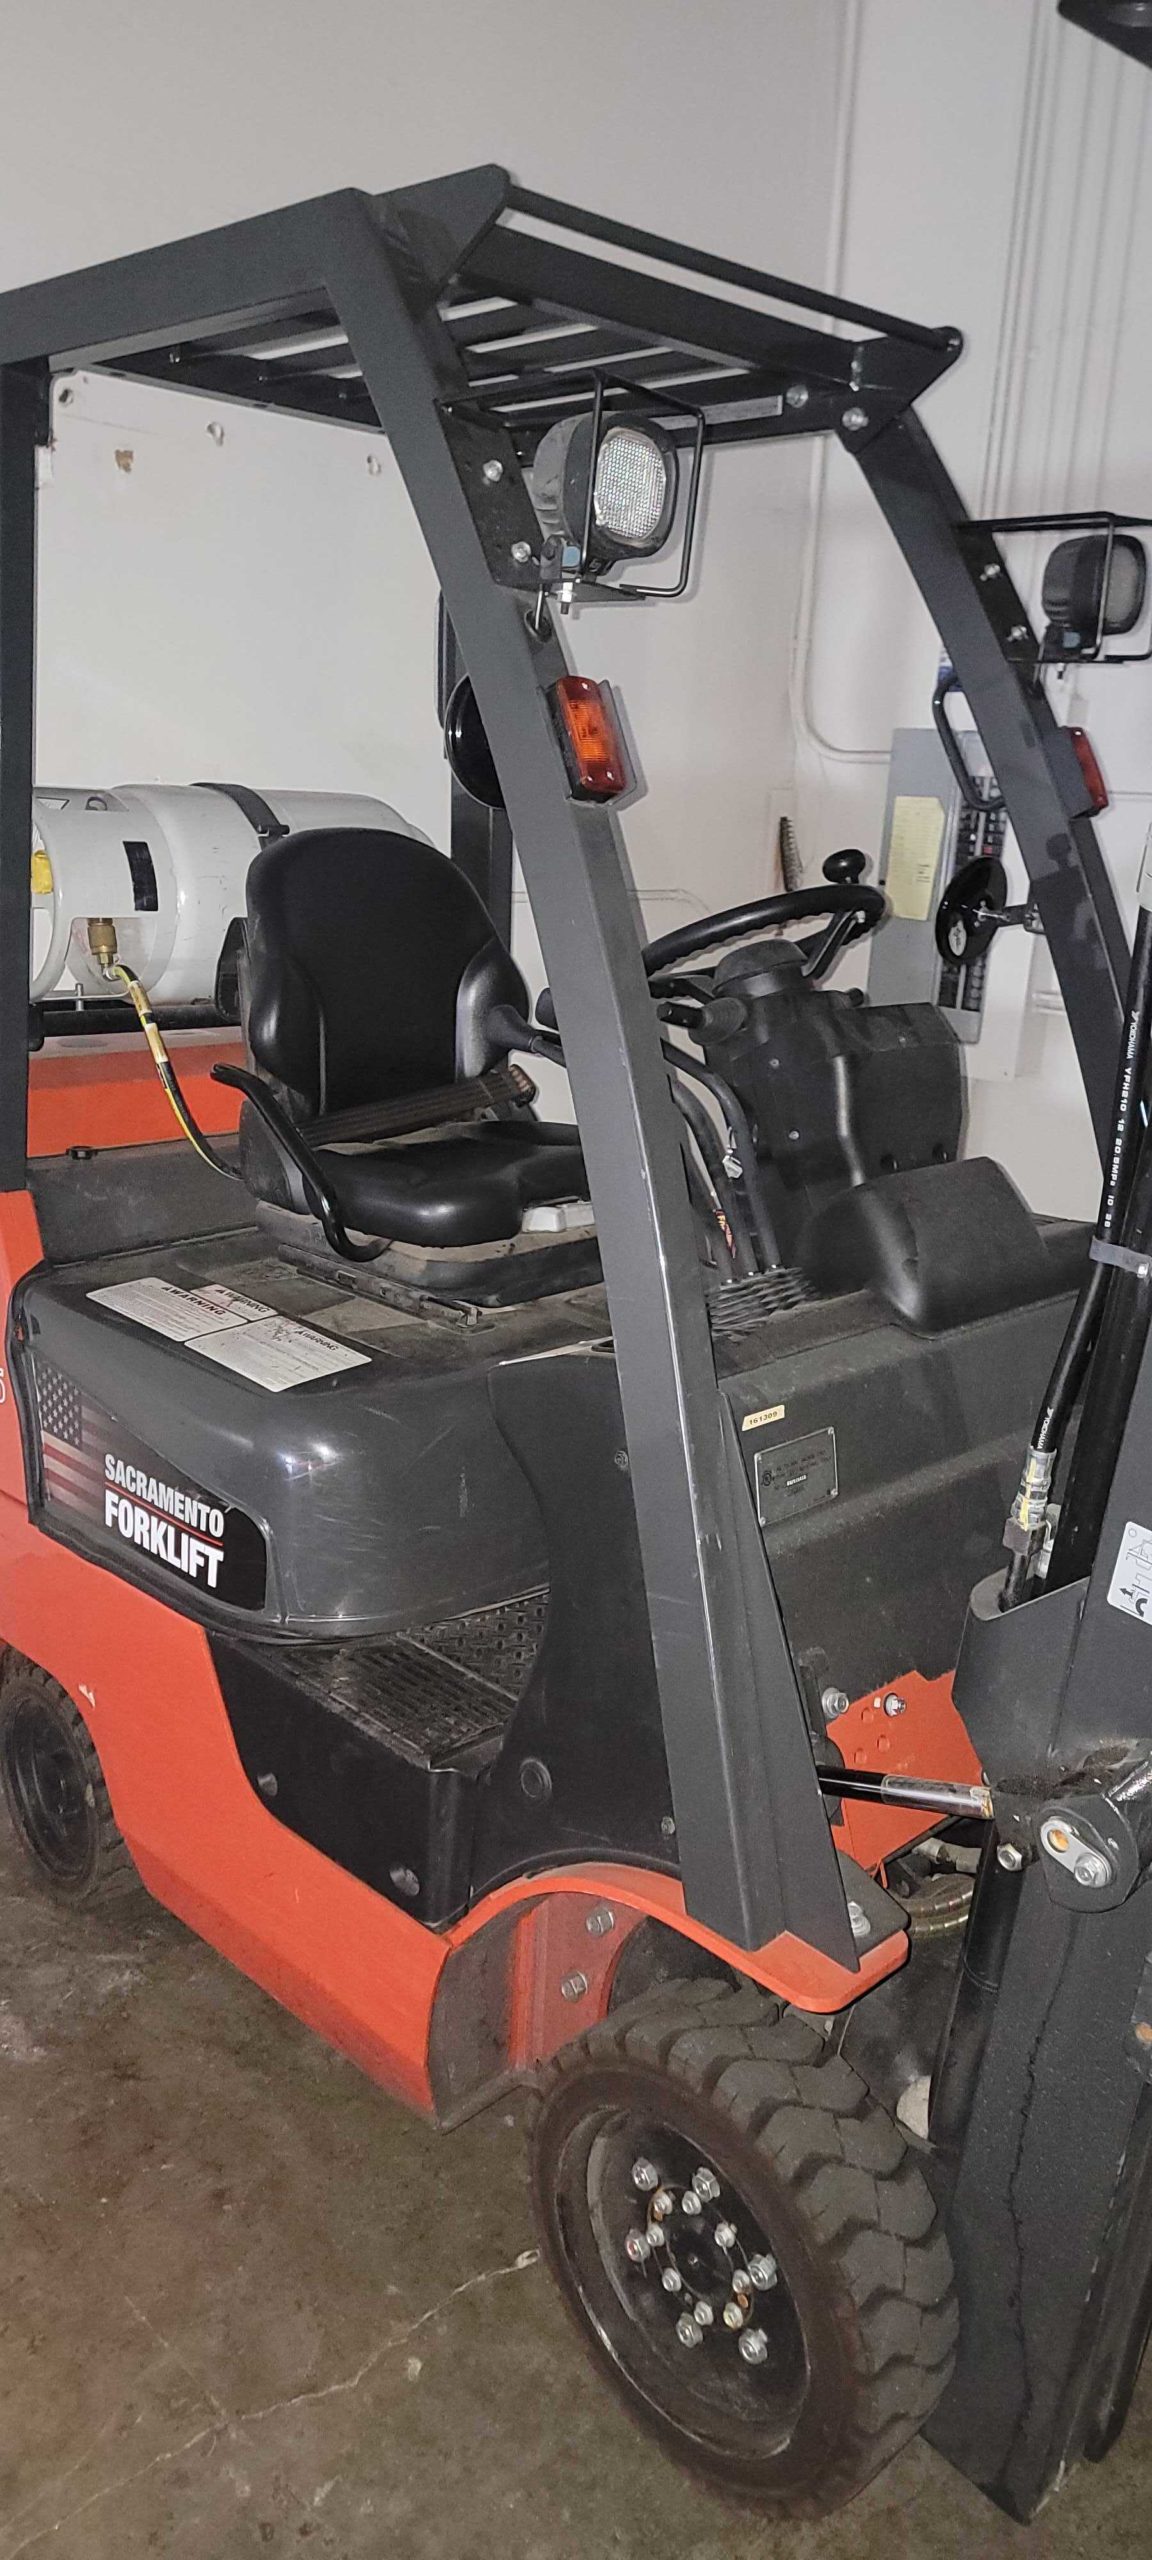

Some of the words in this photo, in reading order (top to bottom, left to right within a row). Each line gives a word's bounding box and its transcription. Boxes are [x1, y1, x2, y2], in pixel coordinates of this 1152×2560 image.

[168, 1289, 226, 1315] WARNING
[224, 1291, 270, 1313] WARNING
[104, 1453, 225, 1538] SACRAMENTO
[104, 1489, 225, 1588] FORKLIFT
